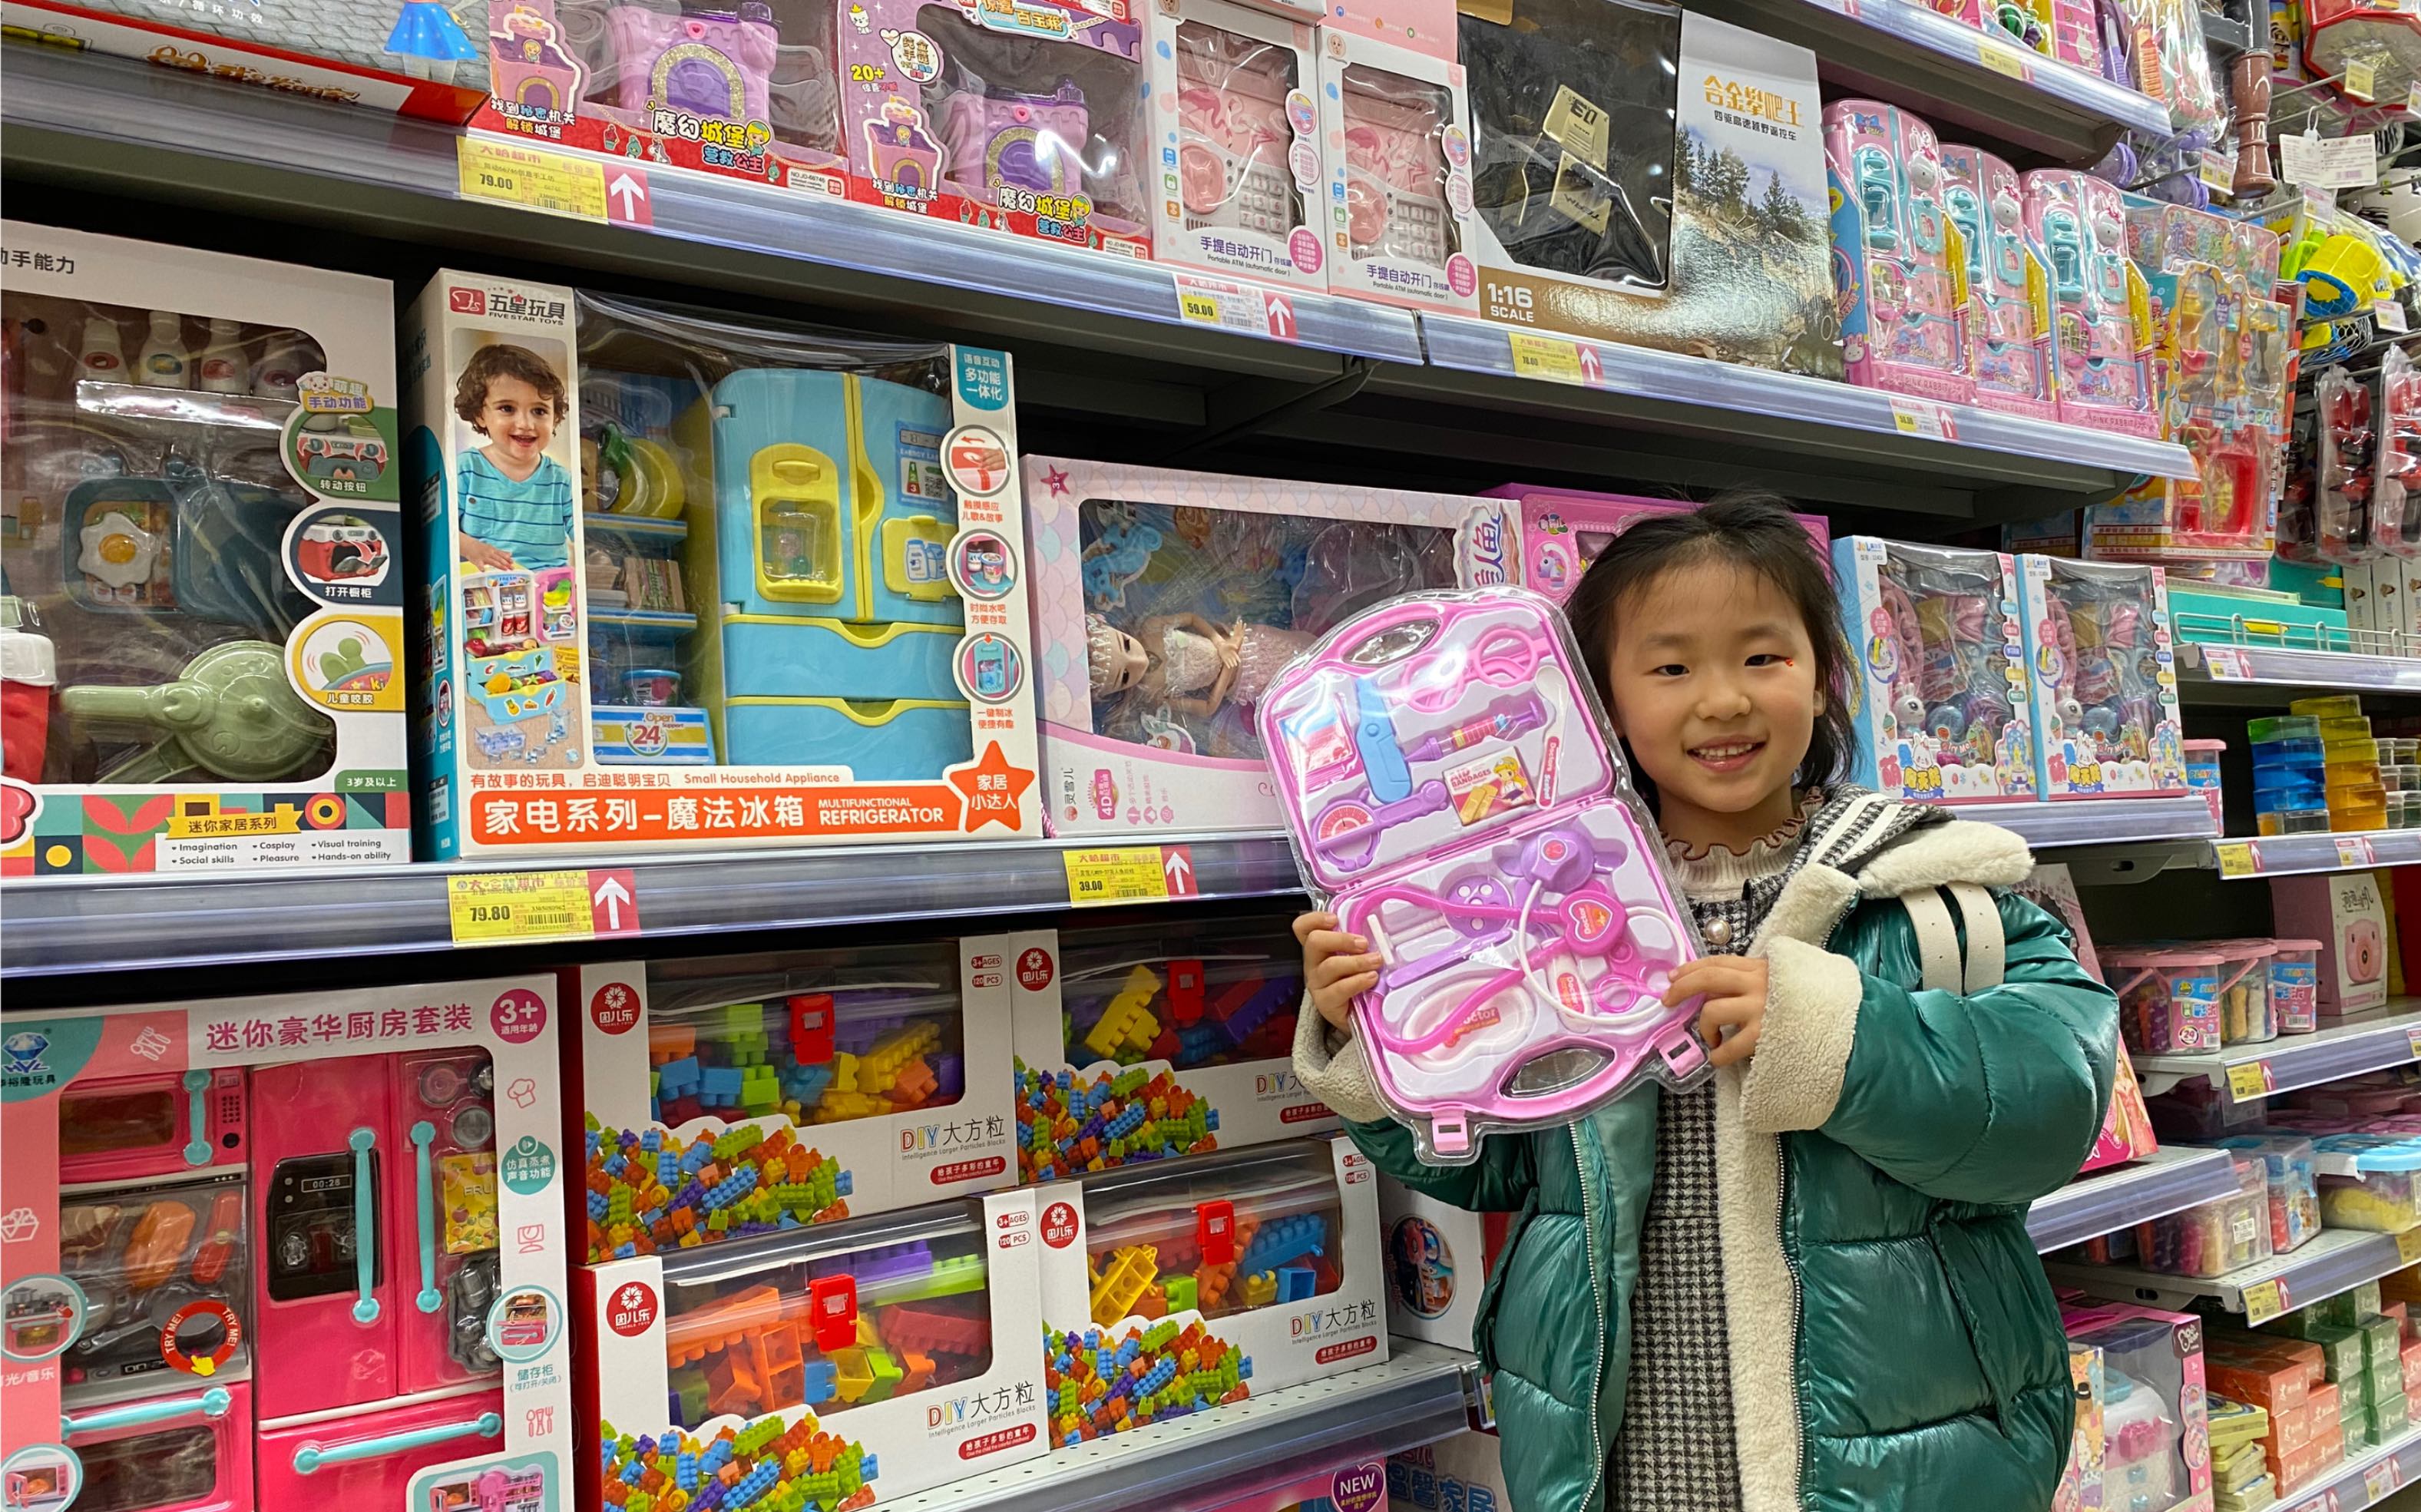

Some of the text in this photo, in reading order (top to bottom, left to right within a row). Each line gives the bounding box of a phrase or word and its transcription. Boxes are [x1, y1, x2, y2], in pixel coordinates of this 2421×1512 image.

[850, 64, 885, 82] 20+
[491, 98, 575, 126] 找到秘密机关
[504, 117, 562, 141] 解锁城堡
[652, 109, 748, 150] 魔幻城堡
[702, 146, 764, 174] 营救公主
[479, 173, 513, 190] 79.00
[872, 178, 938, 202] 找到秘密机关
[884, 194, 928, 215] 解锁城堡
[998, 186, 1073, 222] 魔幻城堡
[1200, 235, 1272, 263] 手提自动开门
[1207, 253, 1231, 265] Portable
[1232, 258, 1245, 268] ATM
[1366, 263, 1432, 289] 手提自动开门
[1372, 280, 1394, 291] Portable
[1394, 285, 1407, 293] ATM
[1487, 281, 1533, 309] 1:16
[488, 293, 564, 319] 五星玩具
[1187, 303, 1214, 317] 59.00
[1490, 306, 1534, 323] SCALE
[511, 313, 535, 323] STAR
[964, 369, 1001, 385] 多功能
[965, 385, 1003, 401] 一体化
[308, 396, 367, 409] 手动功能
[319, 479, 367, 493] 转动按钮
[910, 484, 918, 492] 3
[325, 585, 372, 599] 打开橱柜
[969, 602, 1007, 614] 时尚水吧
[971, 614, 1007, 624] 方便存取
[326, 692, 375, 705] 儿童咬胶
[644, 712, 675, 723] Open
[977, 708, 1014, 719] 一键制冰
[977, 719, 1014, 730] 便捷有趣
[633, 724, 662, 745] 24
[346, 776, 397, 789] 3岁及以上
[684, 773, 840, 786] Small Household Appliance
[977, 774, 1008, 791] 家居
[1451, 769, 1491, 789] BANDAGES
[819, 797, 912, 809] MULTIFUNCTIONAL
[971, 792, 1019, 811] 小达人
[187, 816, 278, 833] 迷你家居系列
[819, 807, 944, 826] REFRIGERATOR
[179, 838, 382, 853] Imagination Cosplay Visual training
[179, 849, 392, 864] Social skills Pleasure Hands-on ability
[1079, 880, 1103, 892] 39.00
[469, 905, 510, 922] 79.80
[1578, 906, 1593, 935] Doctor
[982, 956, 1000, 965] AGES
[986, 974, 999, 984] PCS
[498, 998, 538, 1024] 3+
[205, 1002, 475, 1054] 迷你豪华厨房套装
[500, 1023, 537, 1035] 适用年龄
[1255, 1071, 1288, 1095] DIY
[900, 1114, 1005, 1153] DIY 大方粒
[901, 1138, 1006, 1162] Intelligence Larger Particles Blocks
[507, 1166, 551, 1183] 声音功能
[998, 1213, 1027, 1226] 3+ AGES
[1013, 1233, 1027, 1244] PCS
[1290, 1299, 1377, 1338] DIY 大方粒
[164, 1313, 184, 1355] TRY ME!
[223, 1307, 240, 1348] TRY ME!
[1292, 1320, 1378, 1345] Intelligence Larger Particles Blocks
[0, 1367, 55, 1388] 光/音乐
[517, 1363, 554, 1381] 储存柜
[926, 1379, 1035, 1430] DIY 大方粒
[928, 1404, 1037, 1439] Intelligence Larger Particles Blocks
[1340, 1472, 1375, 1497] NEW
